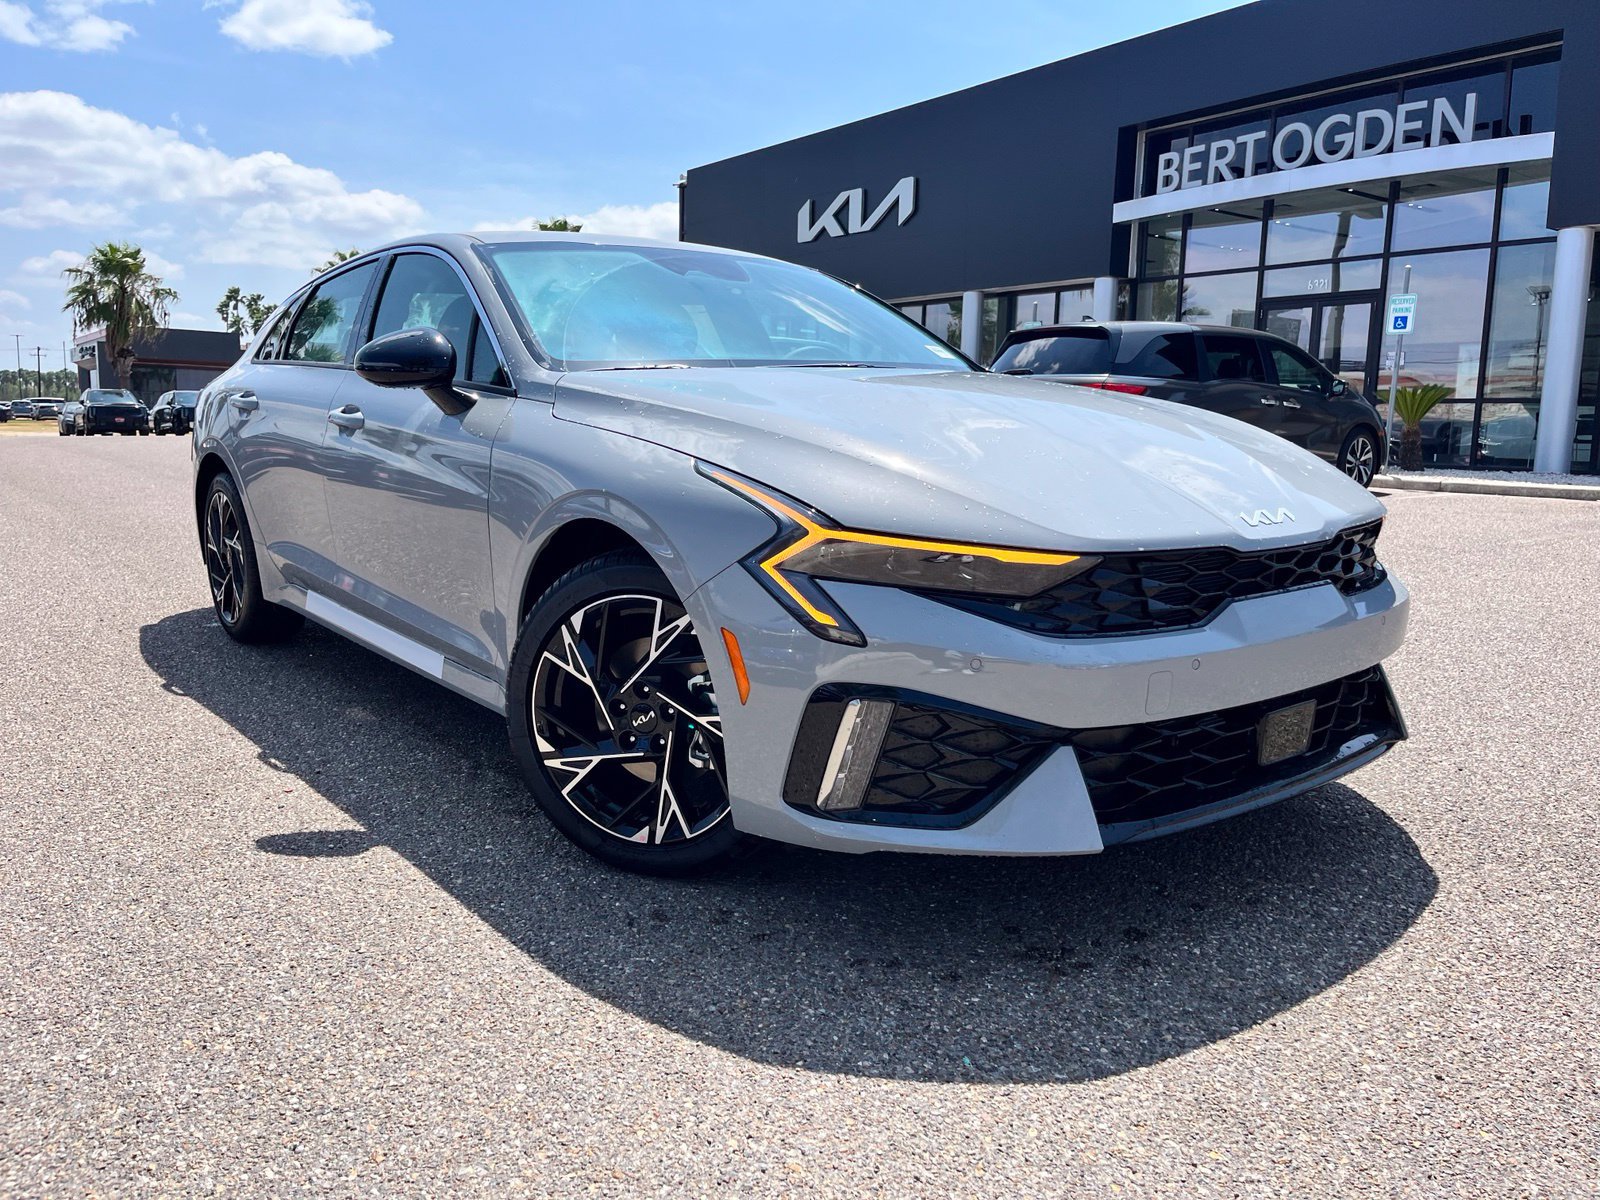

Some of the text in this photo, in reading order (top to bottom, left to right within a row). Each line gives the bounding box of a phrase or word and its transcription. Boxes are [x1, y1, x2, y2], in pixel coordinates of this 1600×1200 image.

[1156, 92, 1477, 195] BERT OGDEN
[797, 176, 917, 244] KIA
[1392, 306, 1412, 314] PARKING
[1240, 507, 1296, 527] KIA
[632, 710, 655, 727] KIA
